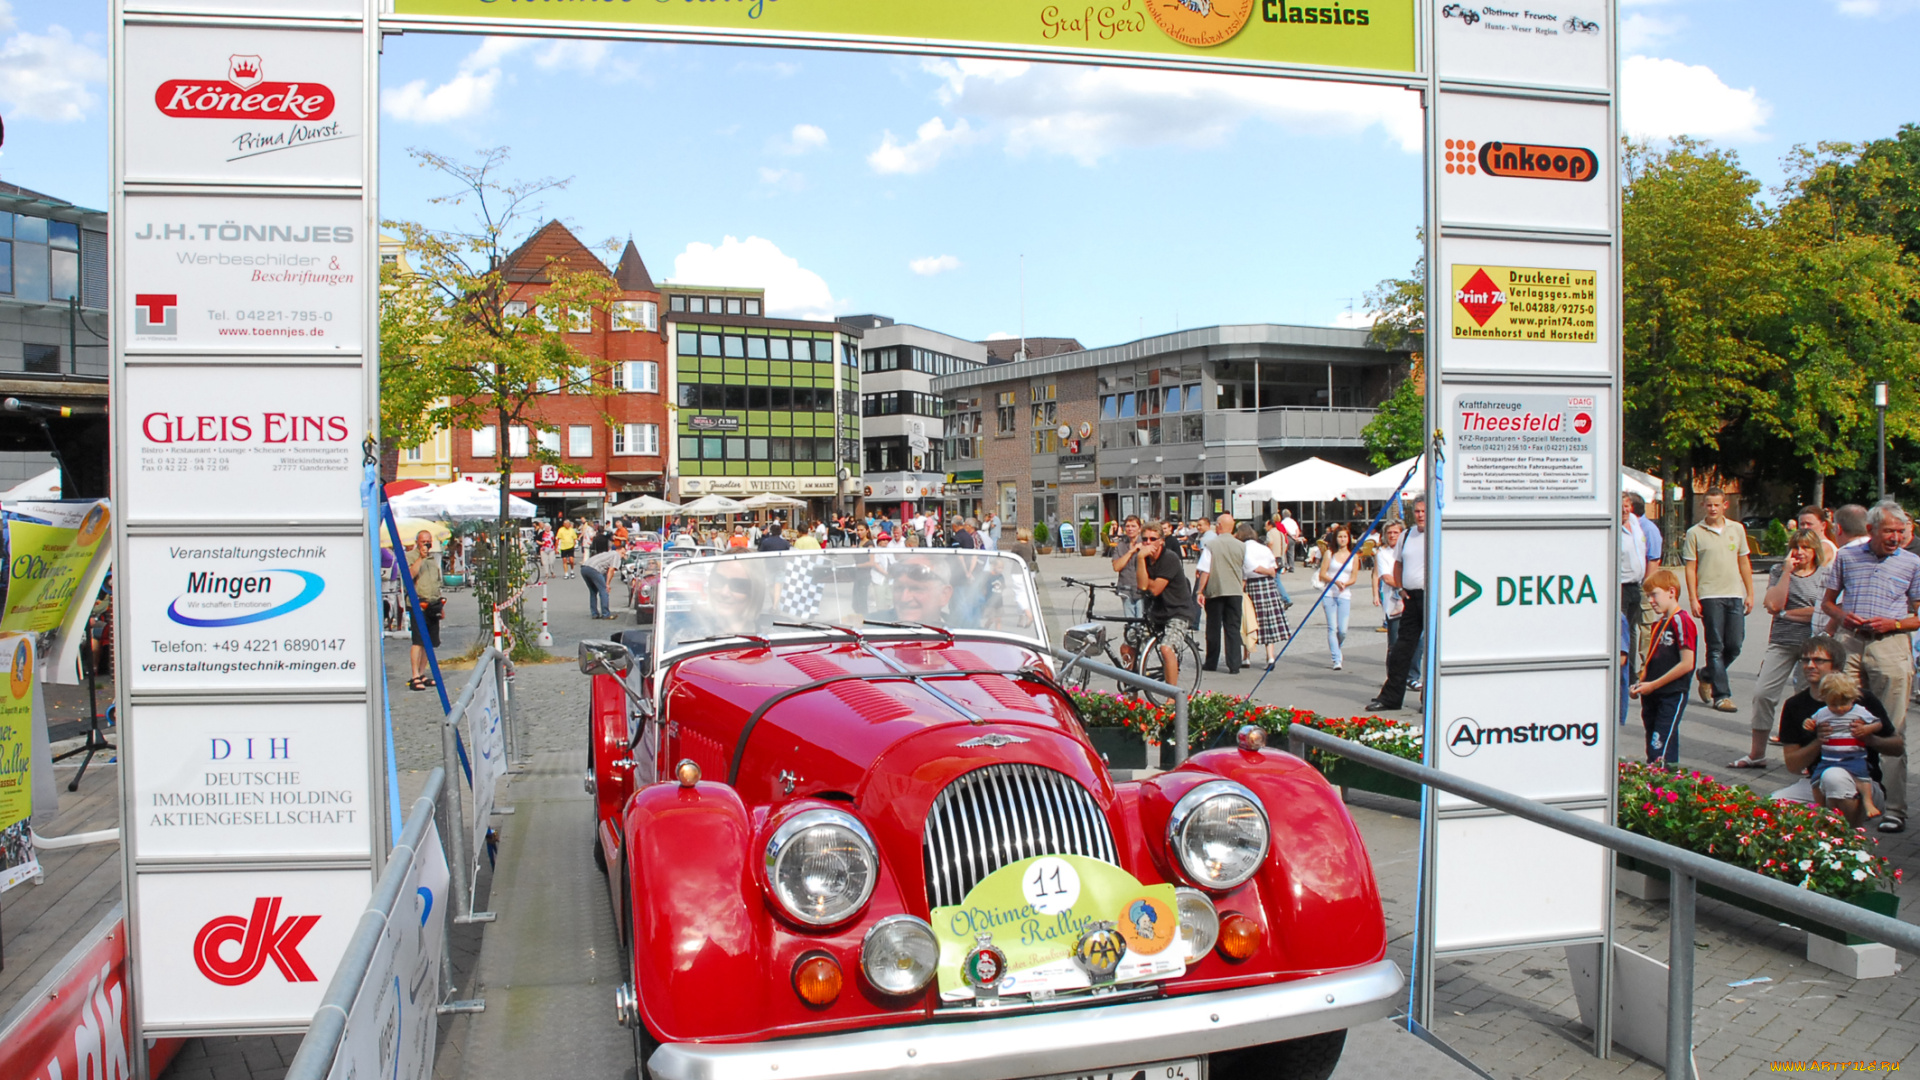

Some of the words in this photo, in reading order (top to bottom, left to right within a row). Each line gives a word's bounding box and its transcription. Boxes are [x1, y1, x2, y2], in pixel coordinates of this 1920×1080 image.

[1262, 0, 1369, 25] Classics
[1482, 7, 1519, 18] Oldtimer
[1524, 11, 1557, 21] Freunde
[1041, 4, 1095, 41] Graf
[1097, 3, 1146, 40] Gerd
[1485, 22, 1505, 31] Hunte
[1511, 24, 1531, 33] Weser
[1535, 27, 1558, 35] Region
[164, 84, 325, 118] Könecke
[232, 131, 284, 151] Prima
[288, 121, 343, 146] Wurst.
[1493, 141, 1586, 178] inkoop
[135, 221, 354, 243] J.H.TÖNNJES
[176, 252, 321, 267] Werbeschilder
[329, 255, 341, 271] &
[251, 269, 354, 286] Beschriftungen
[1509, 271, 1570, 285] Druckerei
[1575, 276, 1594, 286] und
[1455, 289, 1488, 304] Print
[1491, 291, 1507, 304] 74
[1509, 287, 1594, 300] Verlagsges.mbH
[207, 310, 230, 321] Tel.
[236, 310, 333, 322] 04221-795-0
[1510, 317, 1594, 328] www.print74.com
[218, 327, 325, 338] www.toennjes.de
[1455, 327, 1522, 338] Delmenhorst
[1527, 330, 1546, 339] und
[1550, 330, 1594, 341] Horstedt
[1458, 401, 1522, 411] Kraftfahrzeuge
[142, 412, 252, 443] GLEIS
[263, 412, 349, 443] EINS
[1461, 412, 1561, 431] Theesfeld
[1522, 435, 1548, 443] Speziell
[750, 481, 796, 490] WIETING
[170, 546, 327, 562] Veranstaltungstechnik
[187, 572, 271, 599] Mingen
[1496, 574, 1598, 606] DEKRA
[151, 640, 207, 653] Telefon:
[212, 640, 239, 651] +49
[244, 640, 278, 651] 4221
[283, 639, 346, 651] 6890147
[142, 660, 356, 673] veranstaltungstechnik-mingen.de
[1451, 722, 1598, 746] Armstrong
[205, 772, 300, 786] DEUTSCHE
[152, 791, 265, 806] IMMOBILIEN
[270, 790, 352, 804] HOLDING
[150, 810, 357, 826] AKTIENGESELLSCHAFT
[1032, 866, 1067, 896] 11
[950, 903, 1048, 937] Oldtimer-
[1021, 908, 1092, 946] Rallye
[1166, 1066, 1184, 1079] 04
